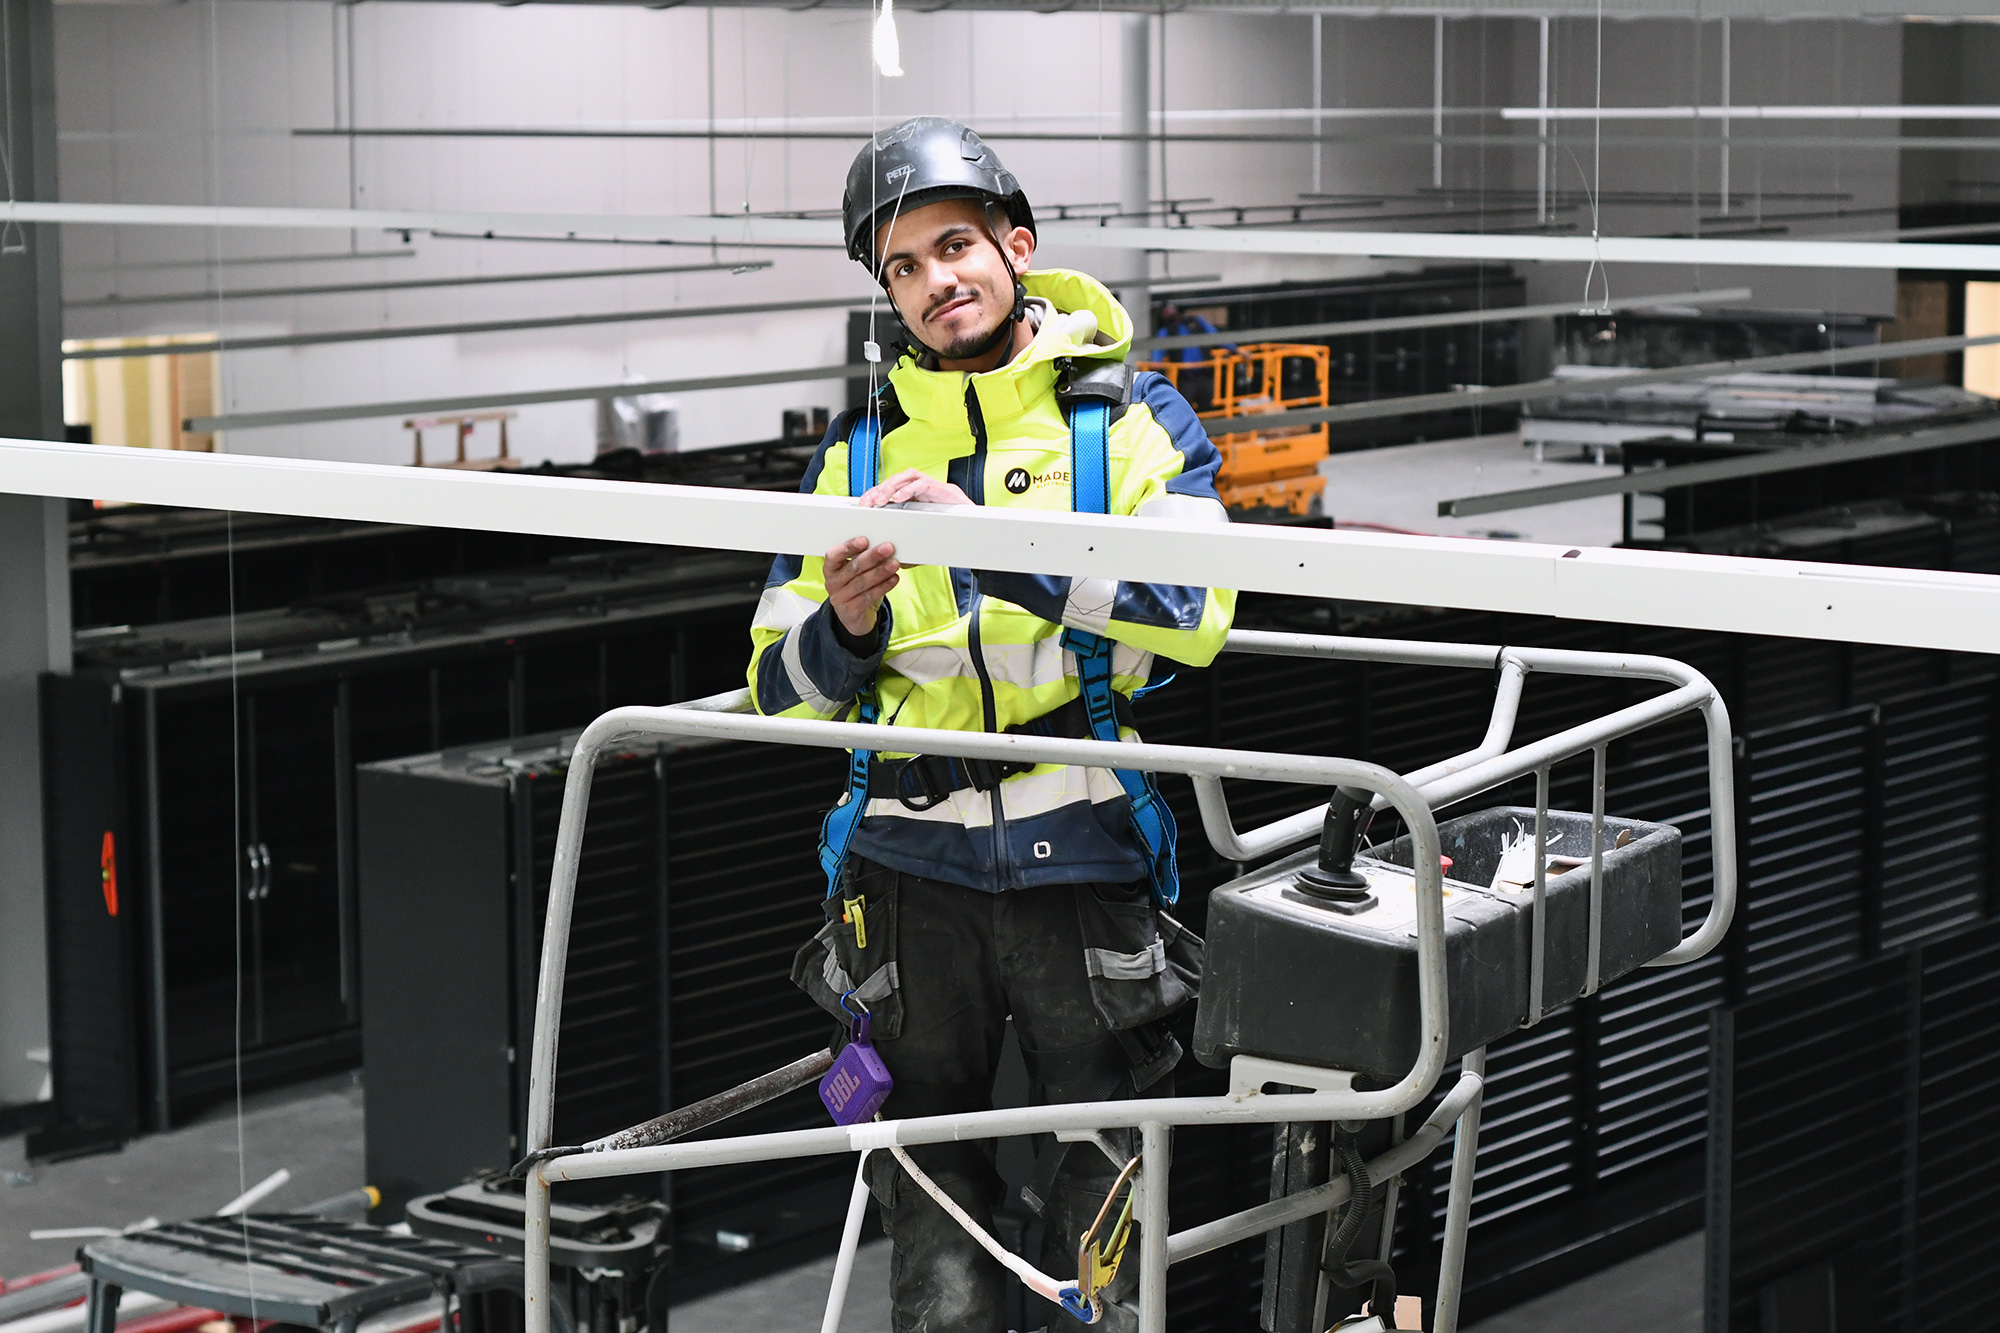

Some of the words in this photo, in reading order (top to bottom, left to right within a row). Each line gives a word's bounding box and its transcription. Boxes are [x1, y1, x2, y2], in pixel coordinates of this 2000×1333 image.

[886, 165, 916, 185] PETZL
[1033, 471, 1070, 484] MADE
[826, 1067, 861, 1112] JBL
